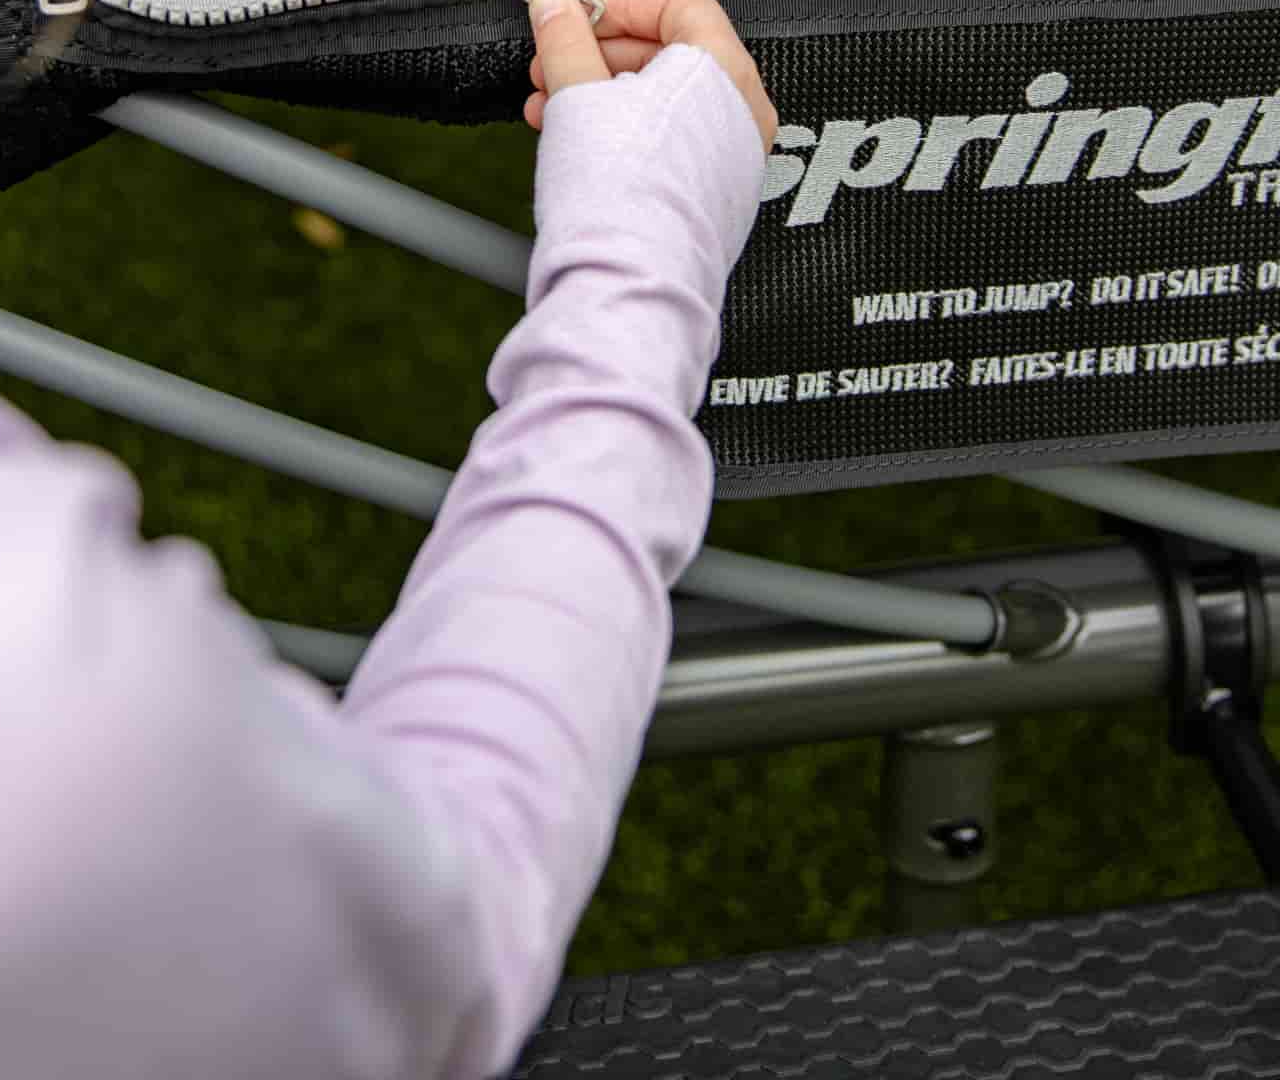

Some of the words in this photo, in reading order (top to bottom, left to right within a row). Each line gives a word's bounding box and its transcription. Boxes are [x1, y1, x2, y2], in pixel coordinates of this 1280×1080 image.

[852, 291, 934, 326] WANT
[933, 288, 976, 317] TO
[977, 280, 1075, 313] JUMP?
[1090, 276, 1131, 304] DO
[1135, 272, 1167, 301] IT
[1164, 264, 1242, 297] SAFE!
[710, 374, 790, 406] ENVIE
[796, 371, 831, 401] DE
[837, 360, 955, 396] SAUTER?
[969, 349, 1096, 386] FAITES-LE
[1099, 346, 1137, 375] EN
[1144, 338, 1230, 372] TOUTE
